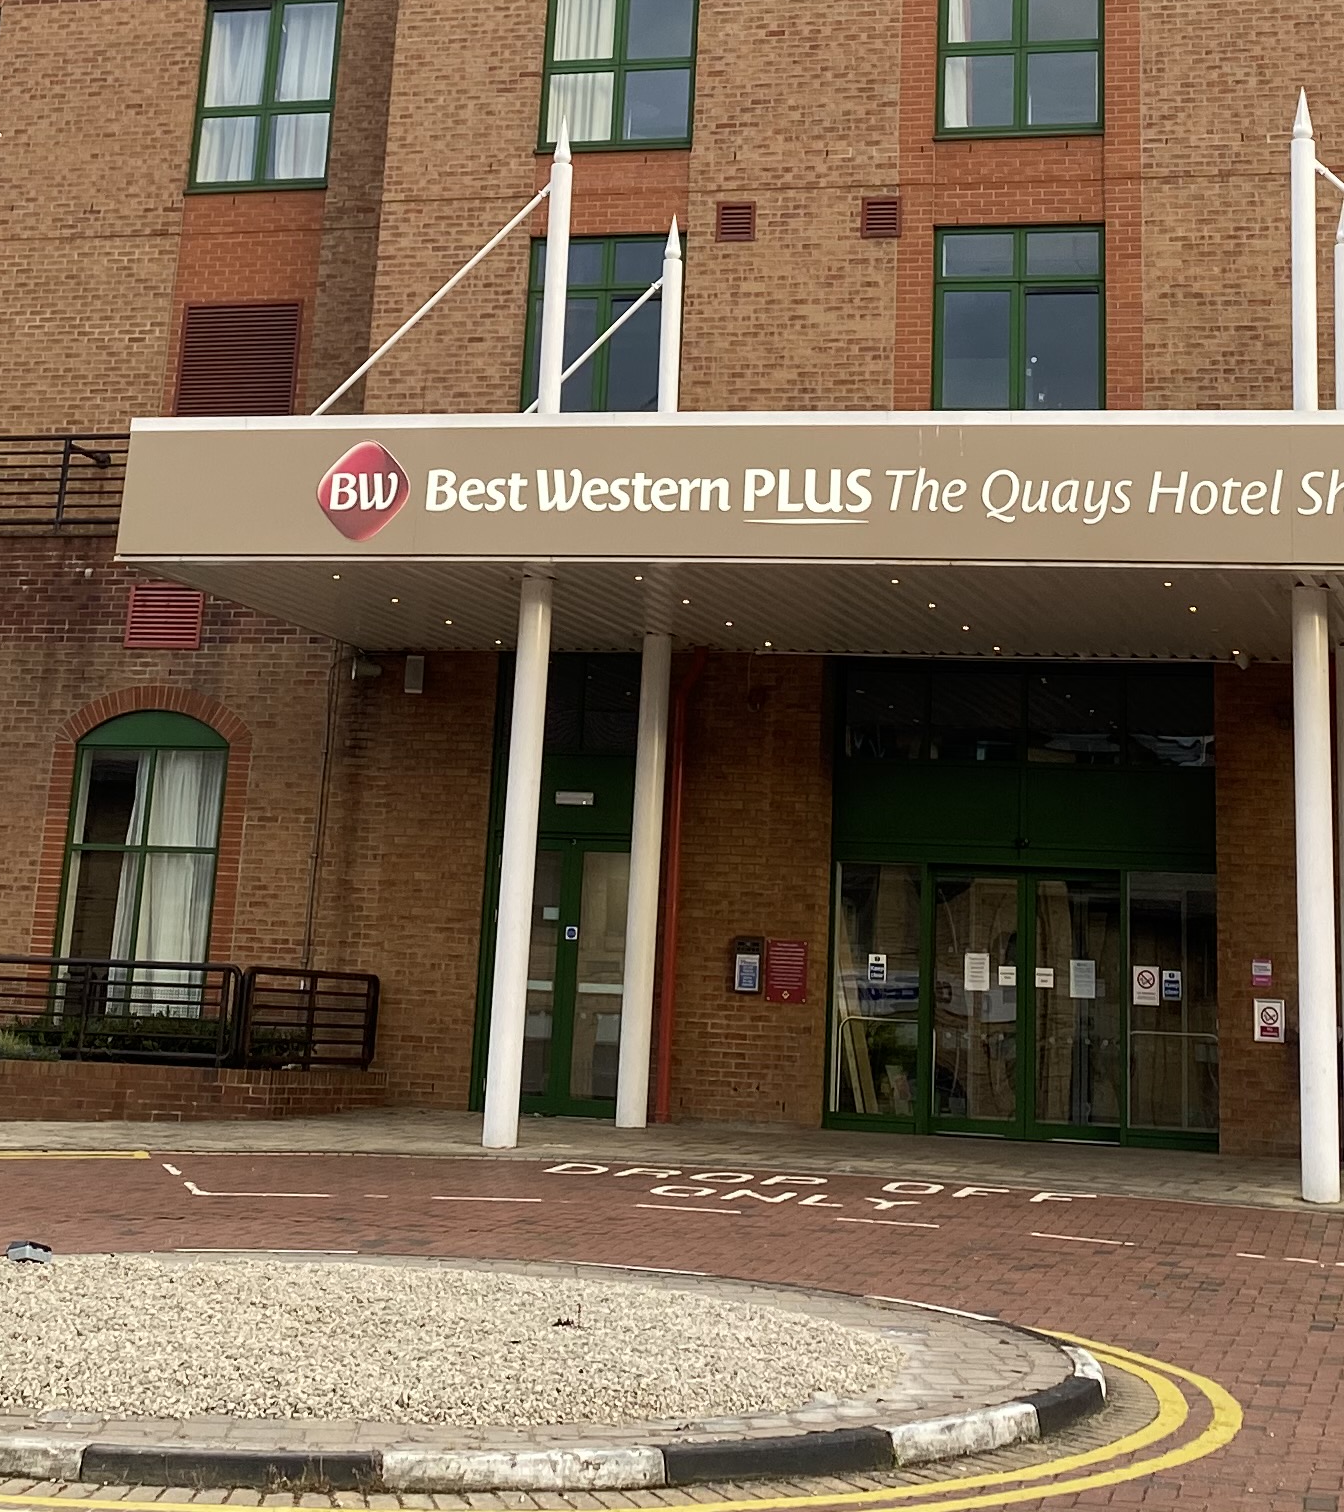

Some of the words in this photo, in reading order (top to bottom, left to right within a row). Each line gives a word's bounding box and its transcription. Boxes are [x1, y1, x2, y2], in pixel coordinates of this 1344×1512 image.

[329, 472, 399, 512] BW
[424, 468, 528, 513] Best
[536, 468, 732, 513] Western
[742, 468, 873, 514] PLUS
[885, 467, 966, 513] The
[981, 468, 1133, 524] Quays
[1148, 469, 1282, 516] Hotel
[542, 1162, 828, 1186] DROP
[881, 1181, 1098, 1202] OFF
[649, 1185, 922, 1210] ONLY
